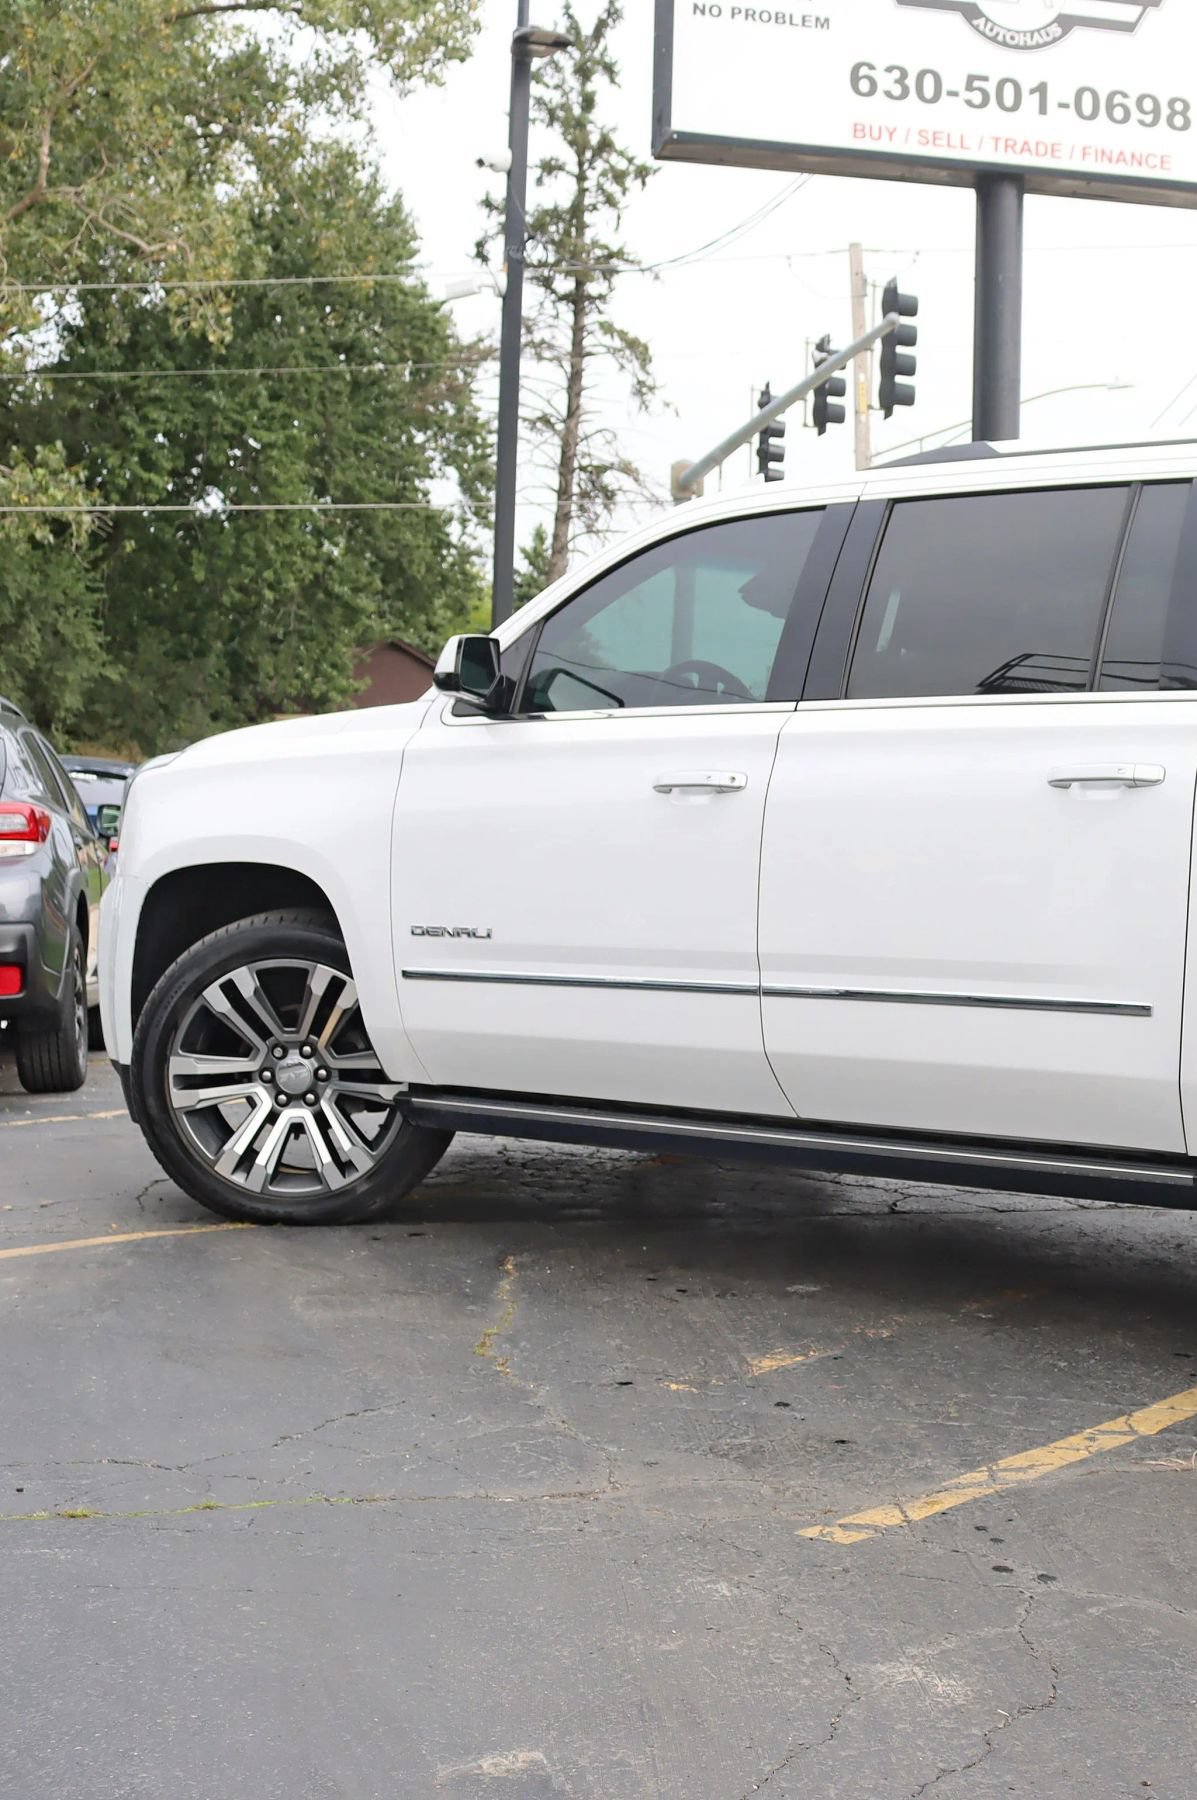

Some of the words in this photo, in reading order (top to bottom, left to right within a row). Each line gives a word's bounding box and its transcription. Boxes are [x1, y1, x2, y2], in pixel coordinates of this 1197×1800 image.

[693, 2, 722, 18] NO
[731, 6, 830, 30] PROBLEM
[972, 17, 1063, 46] AUTOHAUS
[850, 61, 1192, 131] 630-501-0698
[853, 122, 897, 142] BUY
[918, 129, 971, 149] SELL
[991, 136, 1062, 159] TRADE
[1083, 146, 1173, 170] FINANCE
[410, 925, 492, 939] DENALI
